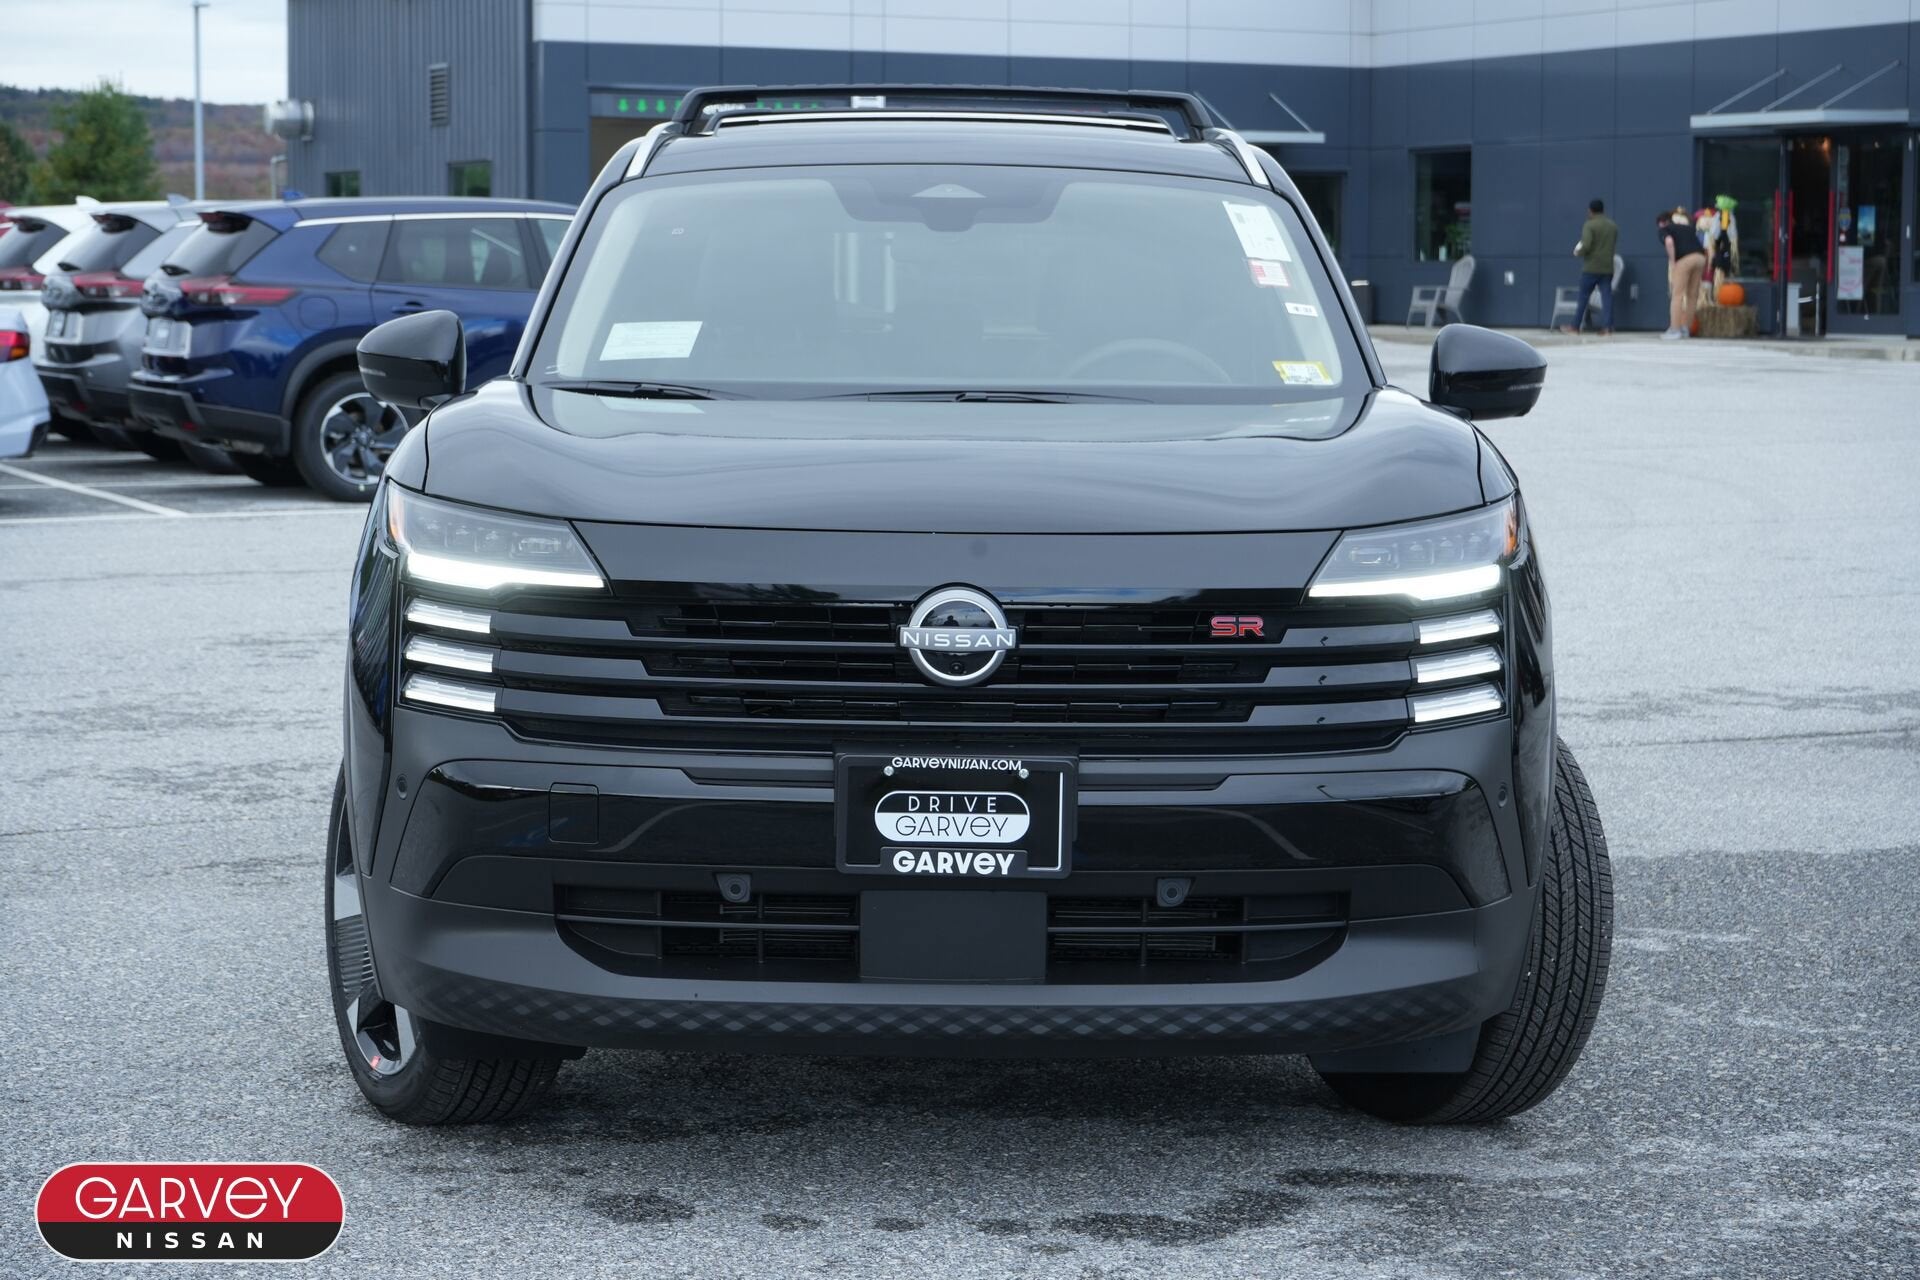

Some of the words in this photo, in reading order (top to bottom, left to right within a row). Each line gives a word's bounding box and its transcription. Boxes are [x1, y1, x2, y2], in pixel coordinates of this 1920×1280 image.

[1210, 616, 1264, 637] SR
[903, 631, 1013, 647] NISSAN
[908, 795, 997, 813] DRIVE
